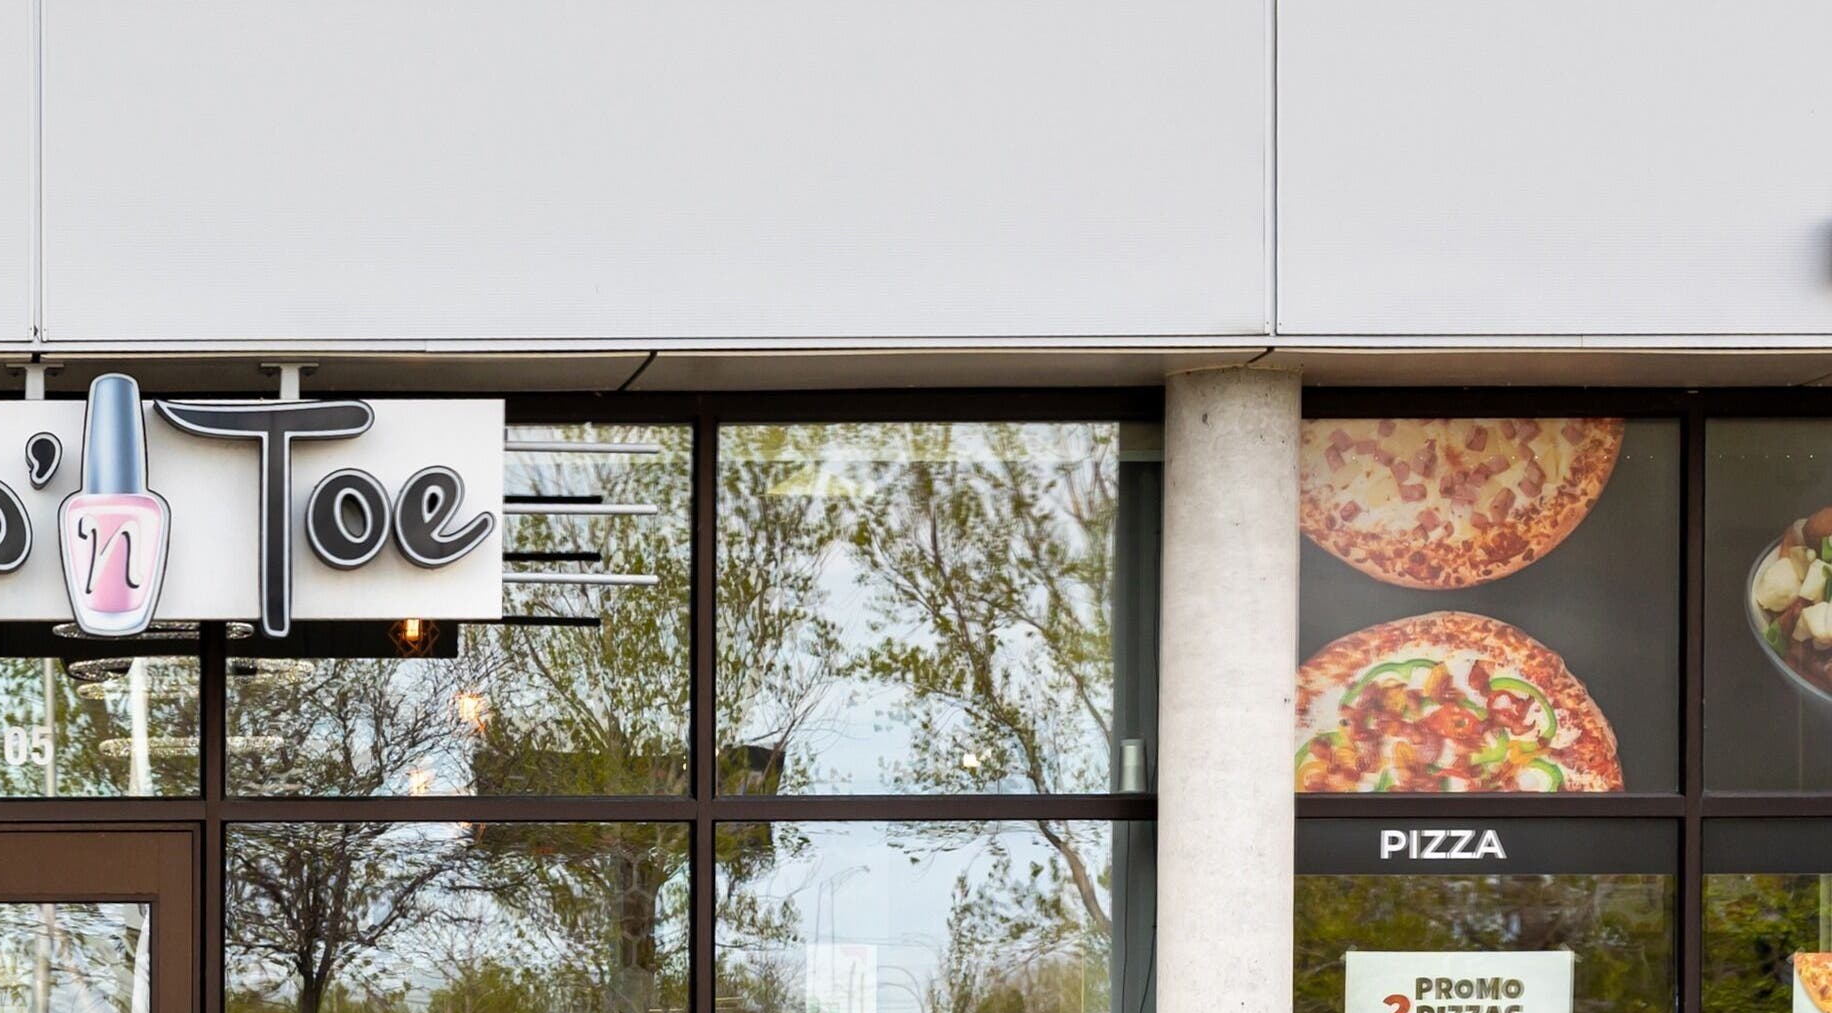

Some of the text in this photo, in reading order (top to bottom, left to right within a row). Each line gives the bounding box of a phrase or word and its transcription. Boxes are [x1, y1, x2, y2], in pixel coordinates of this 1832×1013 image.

[153, 399, 496, 638] Toe
[1380, 829, 1508, 859] PIZZA
[1415, 977, 1525, 1000] PROMO
